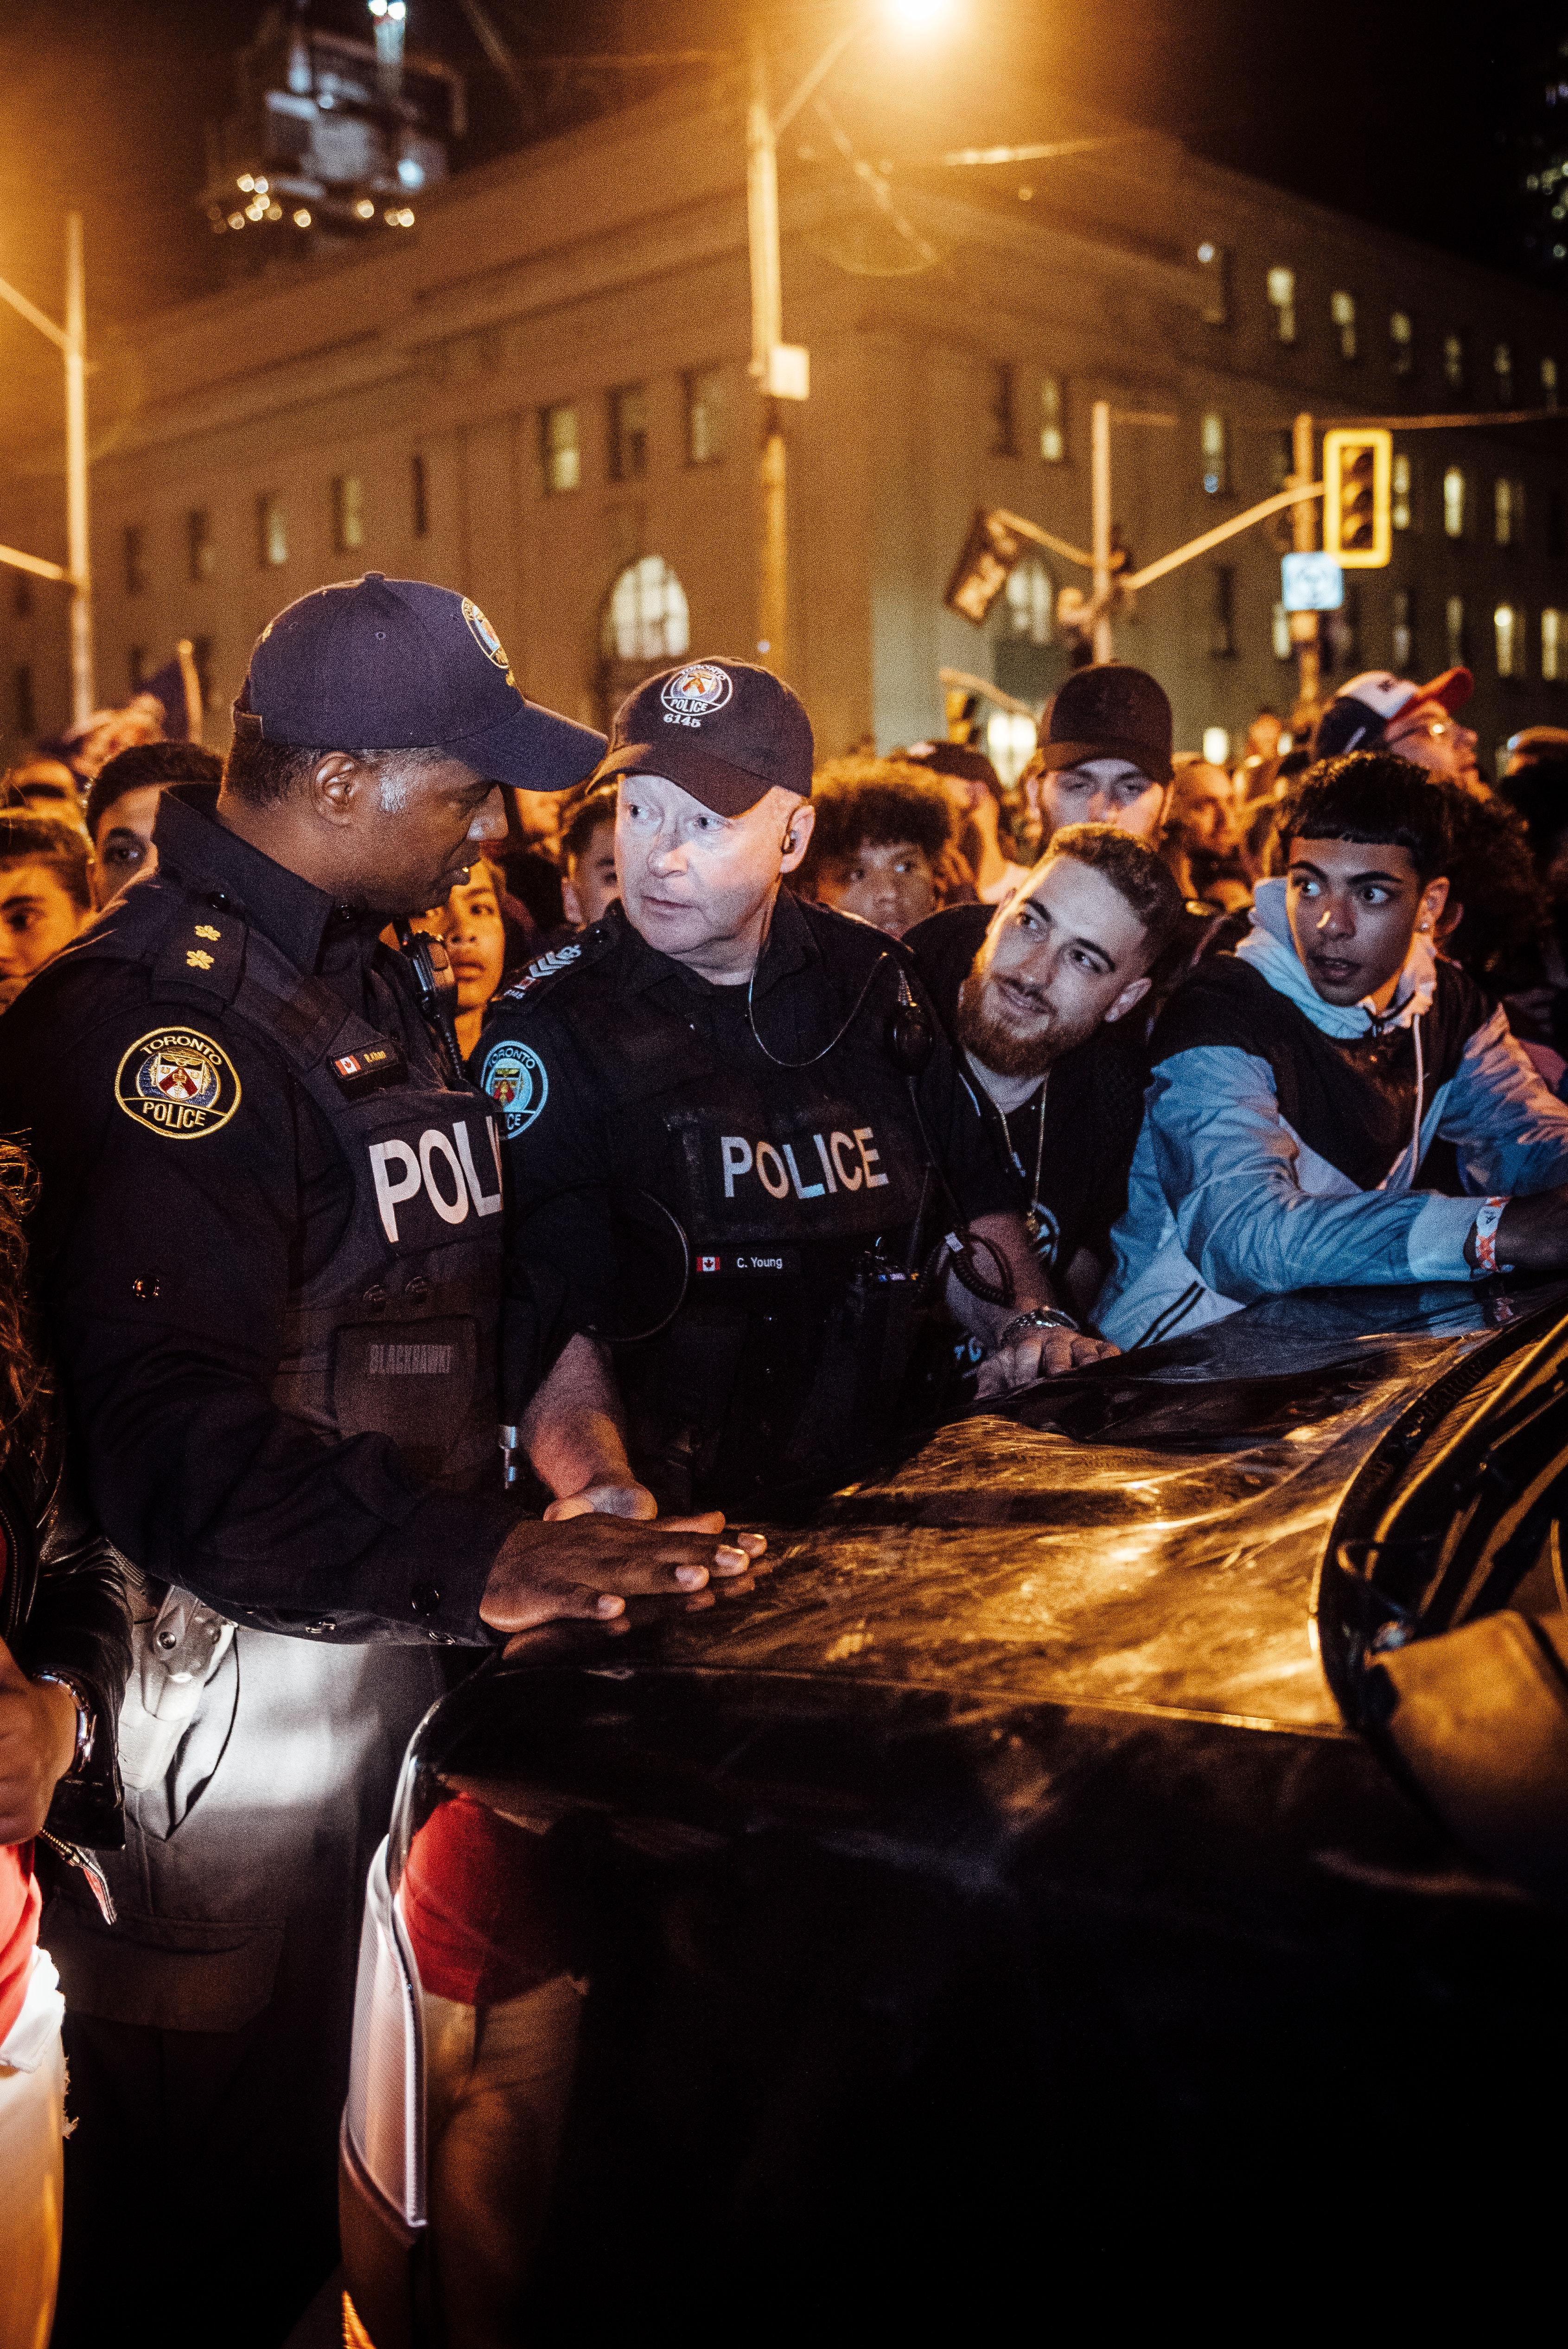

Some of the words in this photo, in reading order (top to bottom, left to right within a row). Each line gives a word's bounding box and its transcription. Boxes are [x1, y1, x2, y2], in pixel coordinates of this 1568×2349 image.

[670, 699, 708, 713] POLICE
[663, 714, 702, 728] 6145
[140, 1036, 222, 1065] TORONTO
[143, 1102, 206, 1128] POLICE
[720, 1127, 889, 1199] POLICE
[737, 1257, 748, 1268] C.
[751, 1257, 783, 1269] Young
